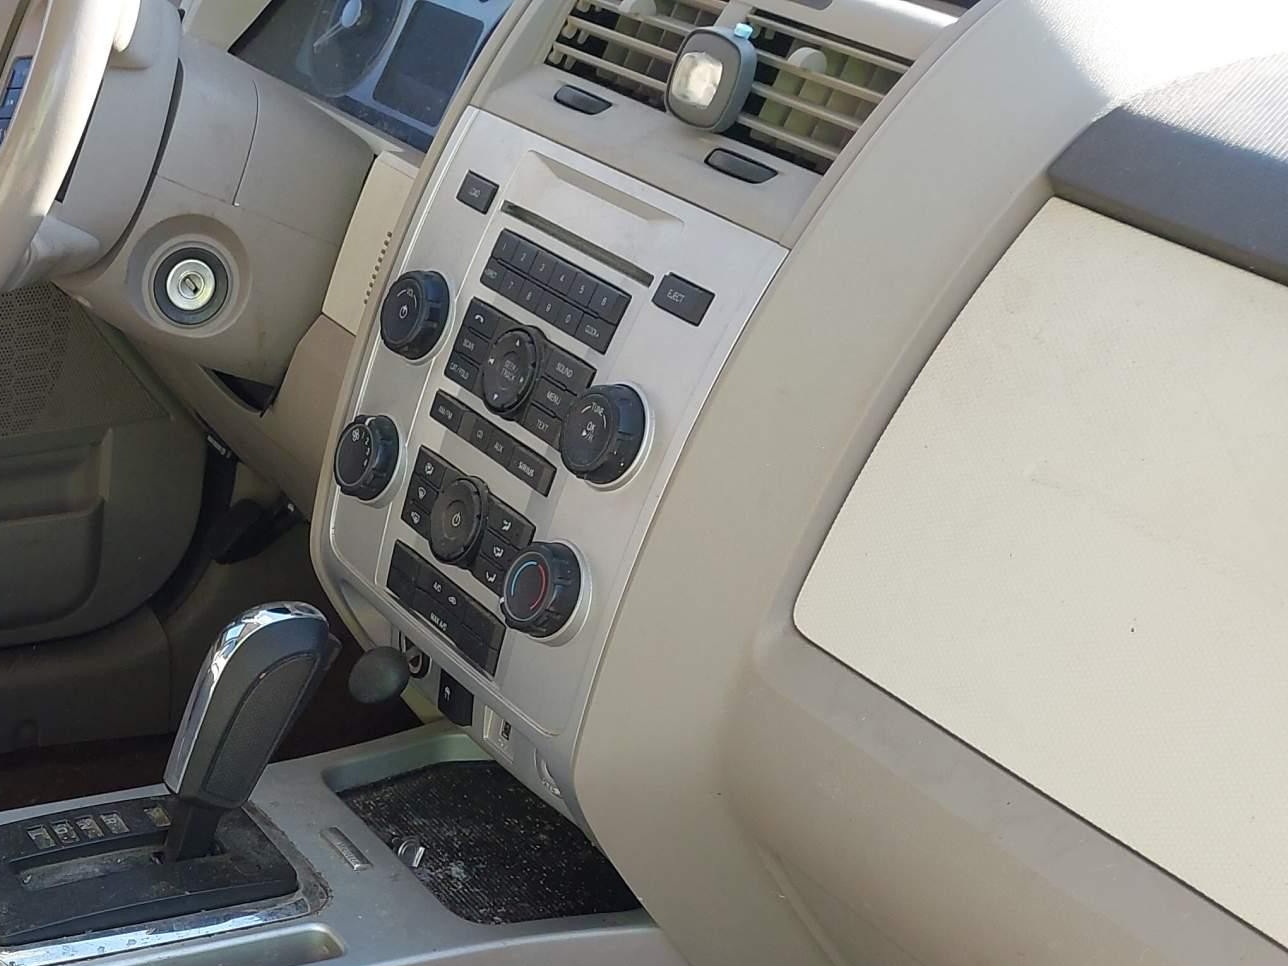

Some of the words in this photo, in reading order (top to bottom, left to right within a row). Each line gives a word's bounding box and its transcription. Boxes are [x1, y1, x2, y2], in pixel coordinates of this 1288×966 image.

[666, 288, 685, 304] EJECT
[555, 362, 574, 378] SOUND
[546, 391, 561, 405] MENU
[590, 401, 606, 417] TUNE
[536, 418, 549, 432] TEXT
[586, 420, 597, 432] OK
[493, 441, 505, 453] AUX
[518, 460, 536, 478] SIRIUS
[432, 581, 443, 593] A/C
